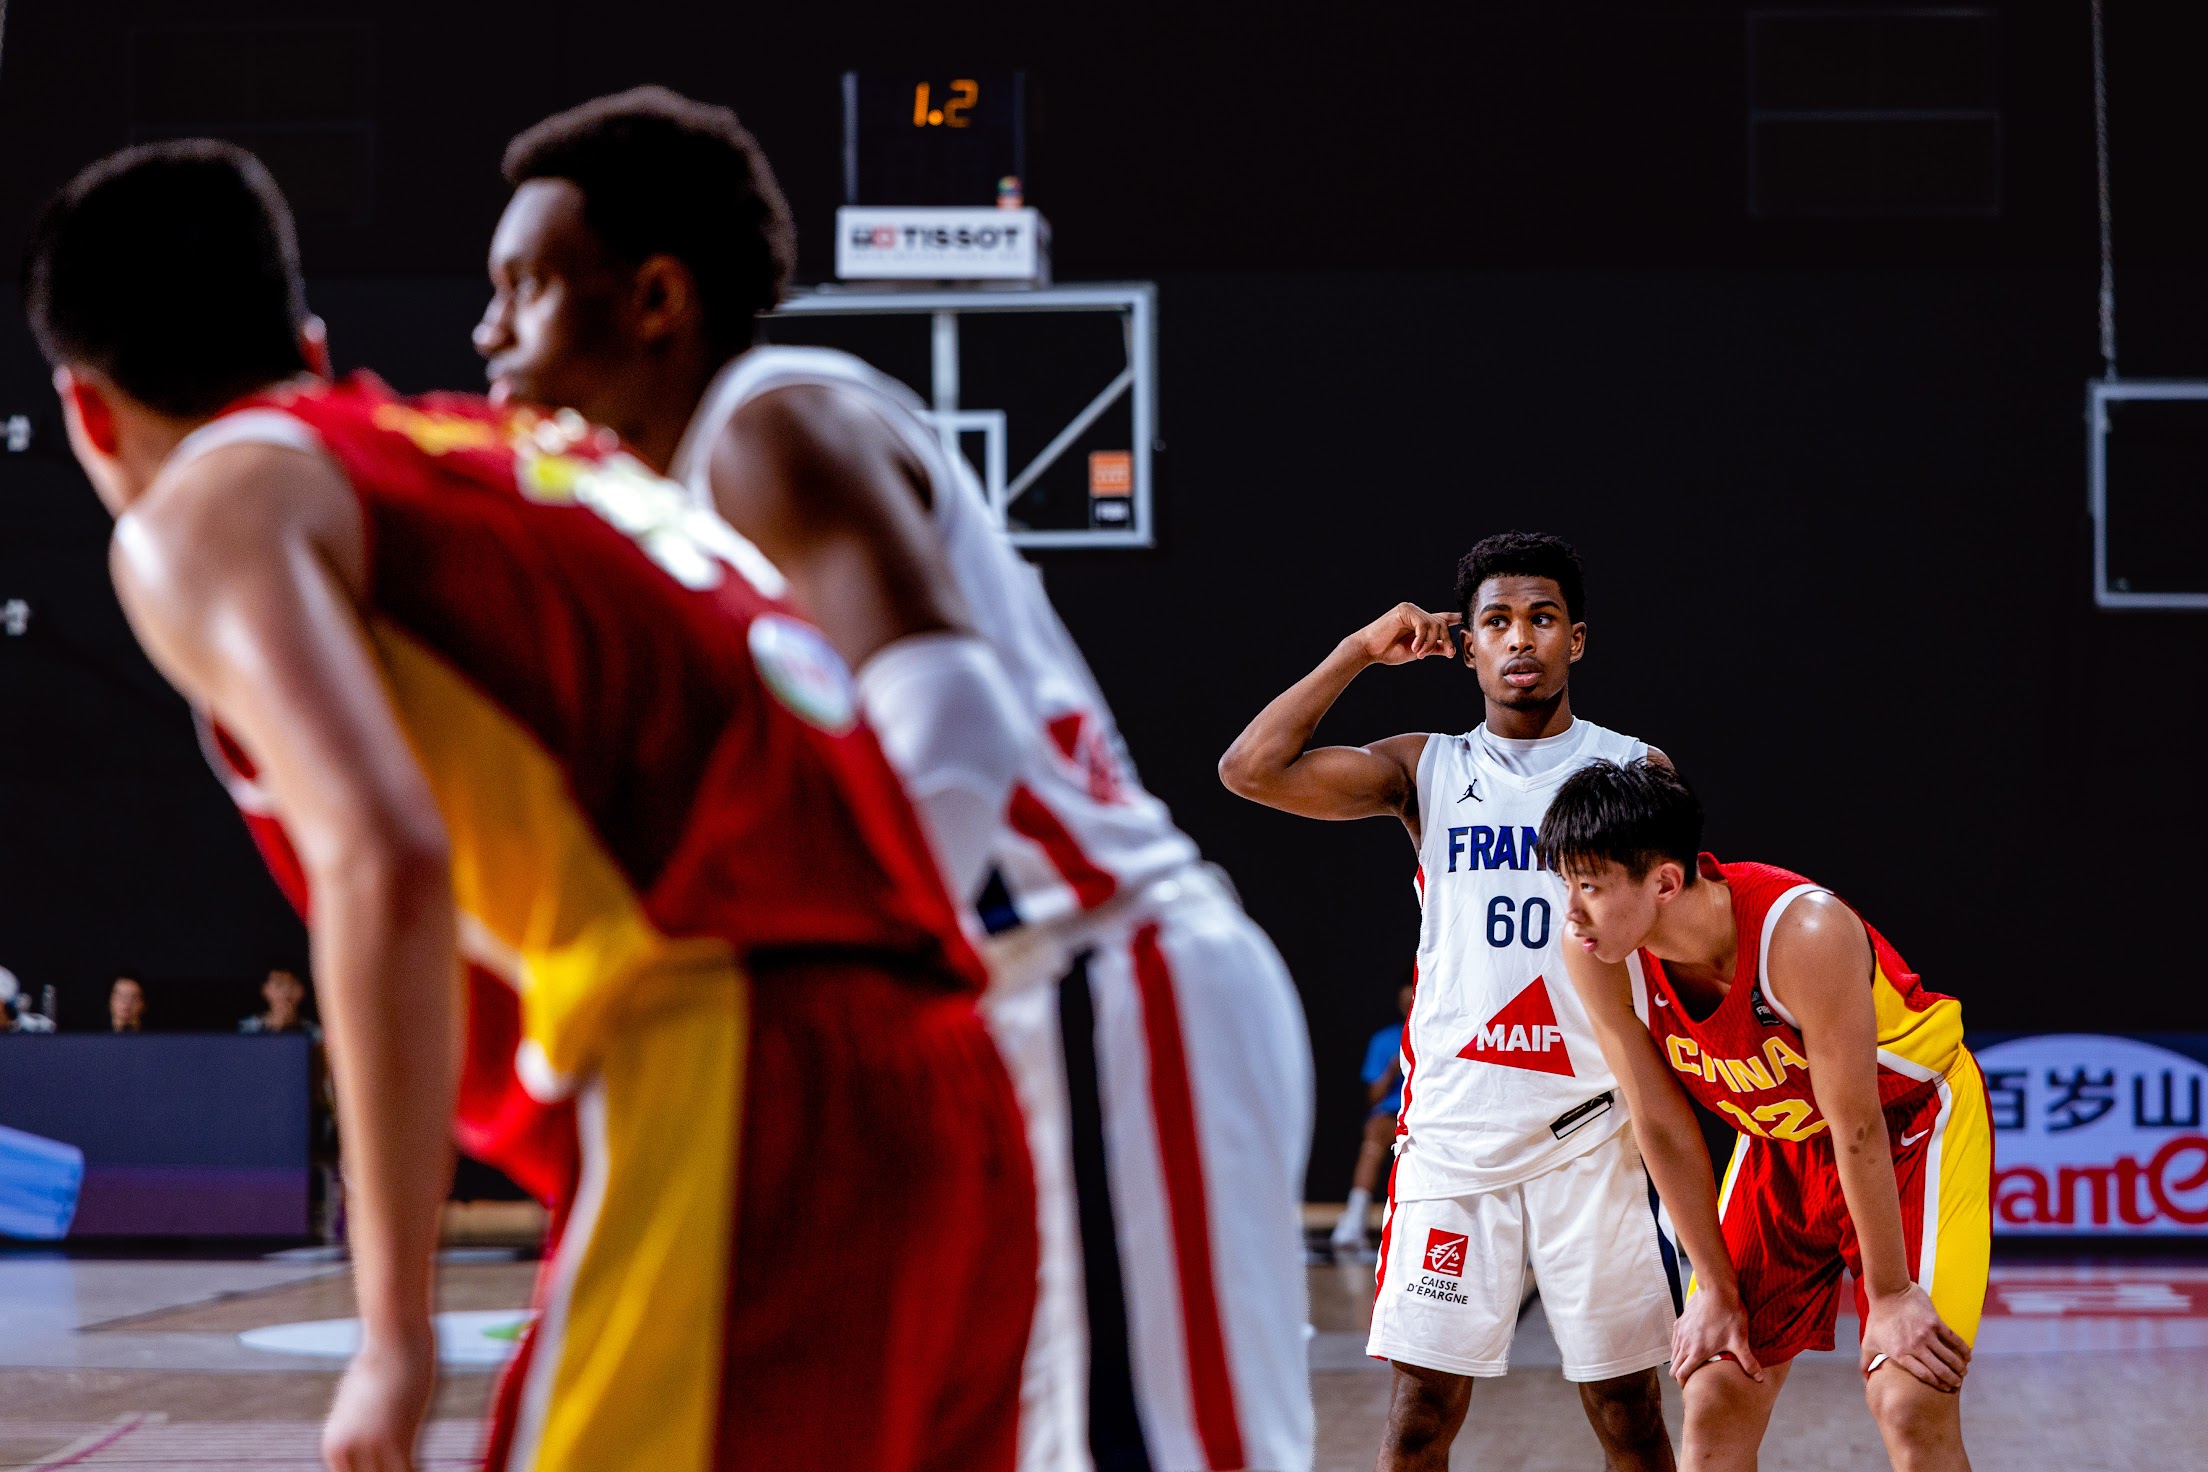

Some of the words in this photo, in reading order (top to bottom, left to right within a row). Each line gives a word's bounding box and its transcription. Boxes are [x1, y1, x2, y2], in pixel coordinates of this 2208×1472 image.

[913, 78, 979, 128] 1.2
[904, 225, 1019, 250] TISSOT
[1447, 825, 1556, 874] FRAN
[1486, 895, 1551, 950] 60
[1476, 1023, 1561, 1053] MAIF
[1716, 1098, 1830, 1142] 12
[1993, 1133, 2208, 1225] ante
[1421, 1276, 1458, 1292] CAISSE
